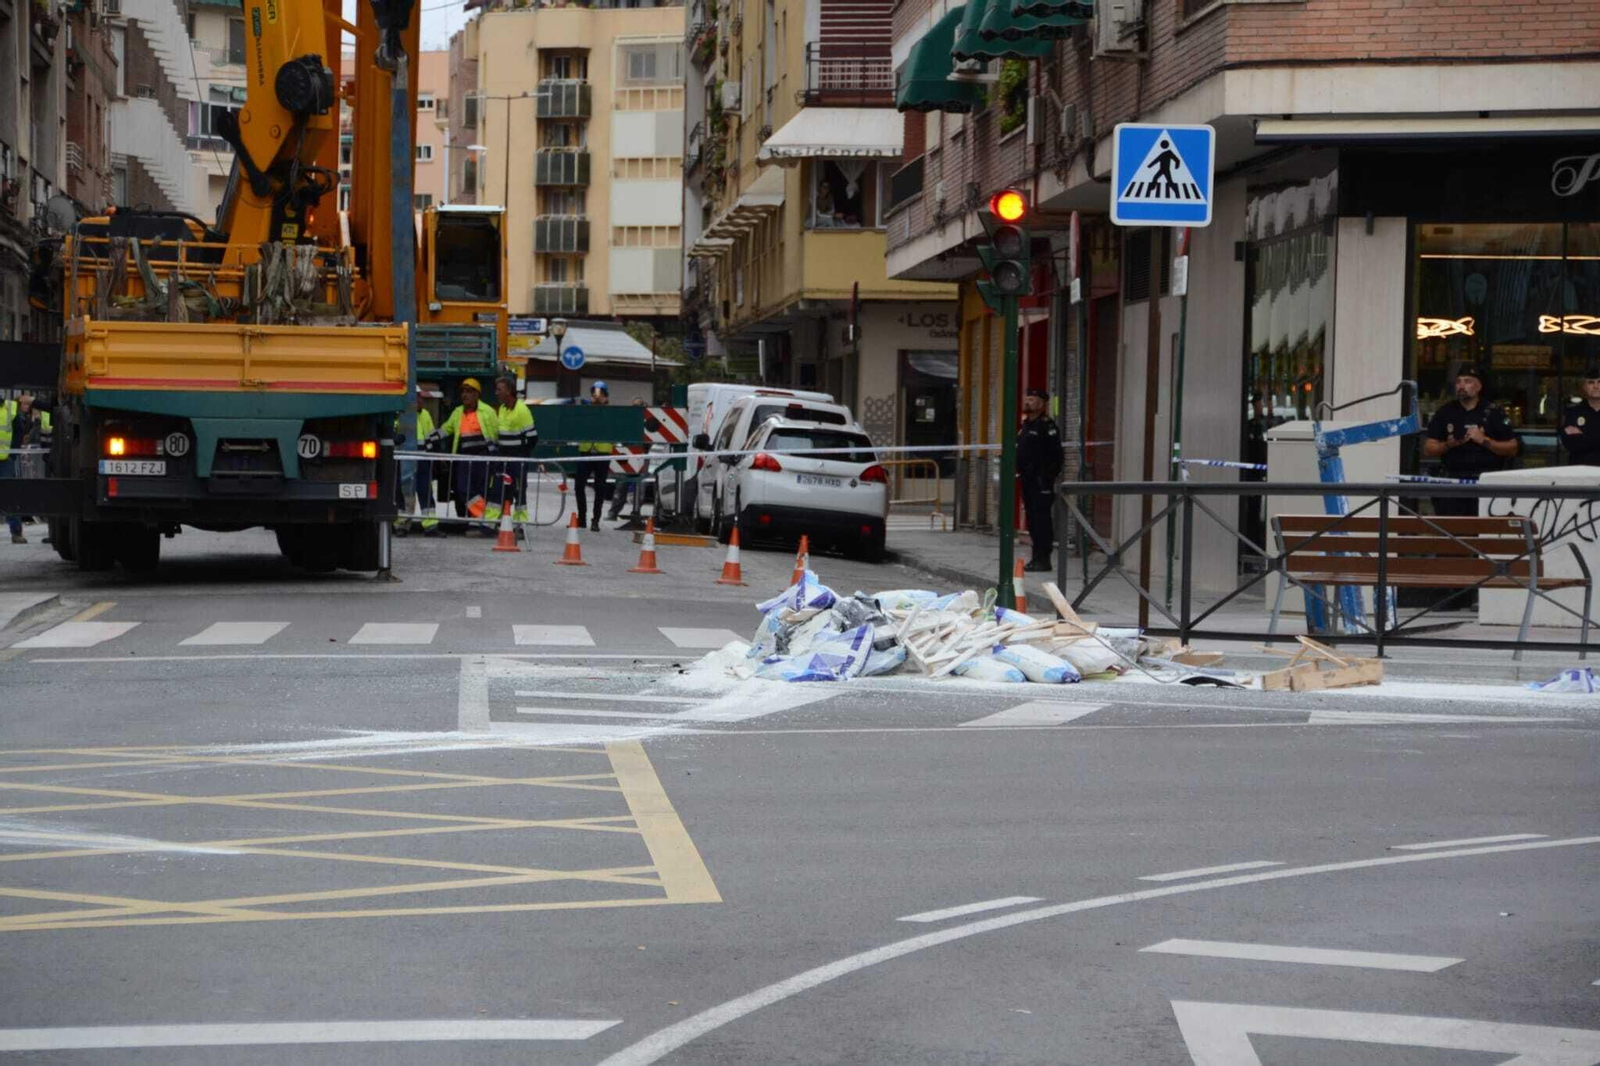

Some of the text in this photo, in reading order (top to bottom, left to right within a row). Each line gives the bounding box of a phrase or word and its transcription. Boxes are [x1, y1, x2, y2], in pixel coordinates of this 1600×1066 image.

[907, 313, 949, 327] LOS
[169, 435, 186, 454] 80
[300, 438, 317, 455] 70
[109, 461, 164, 474] 1612 FZJ
[342, 485, 364, 498] SP
